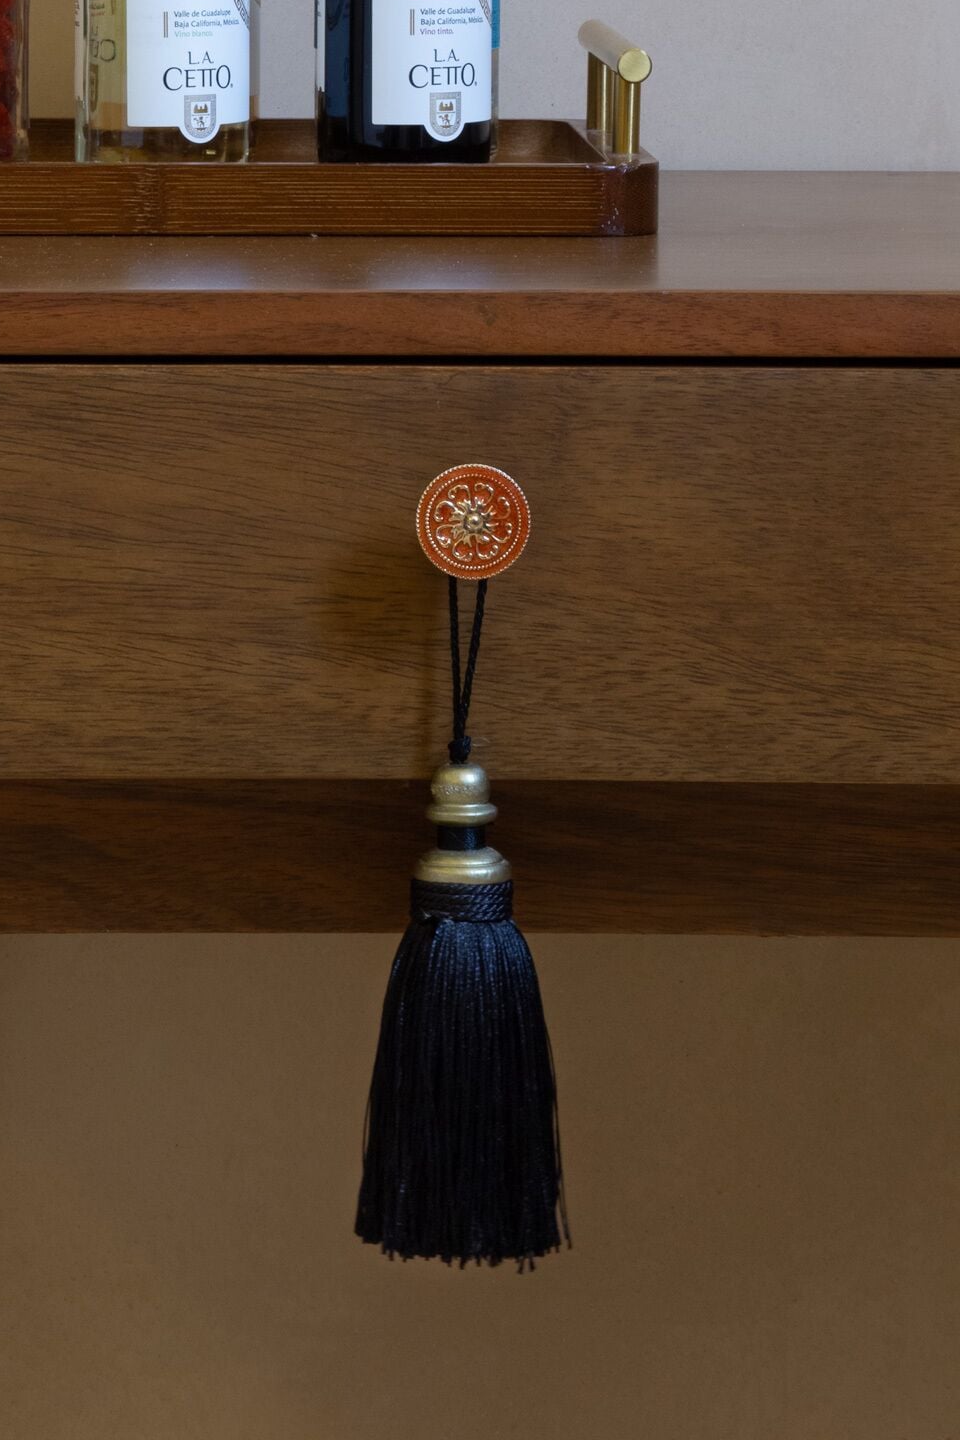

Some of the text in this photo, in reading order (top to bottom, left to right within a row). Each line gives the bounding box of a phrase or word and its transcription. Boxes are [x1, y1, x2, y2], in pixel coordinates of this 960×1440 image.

[173, 8, 231, 18] Valle de Guadalupe
[420, 6, 476, 16] Valle de Guadalupe
[174, 20, 189, 29] Baja
[191, 18, 222, 28] California,
[420, 18, 435, 27] Baja
[437, 16, 468, 26] California,
[174, 30, 190, 38] Vino
[420, 27, 436, 35] Vino
